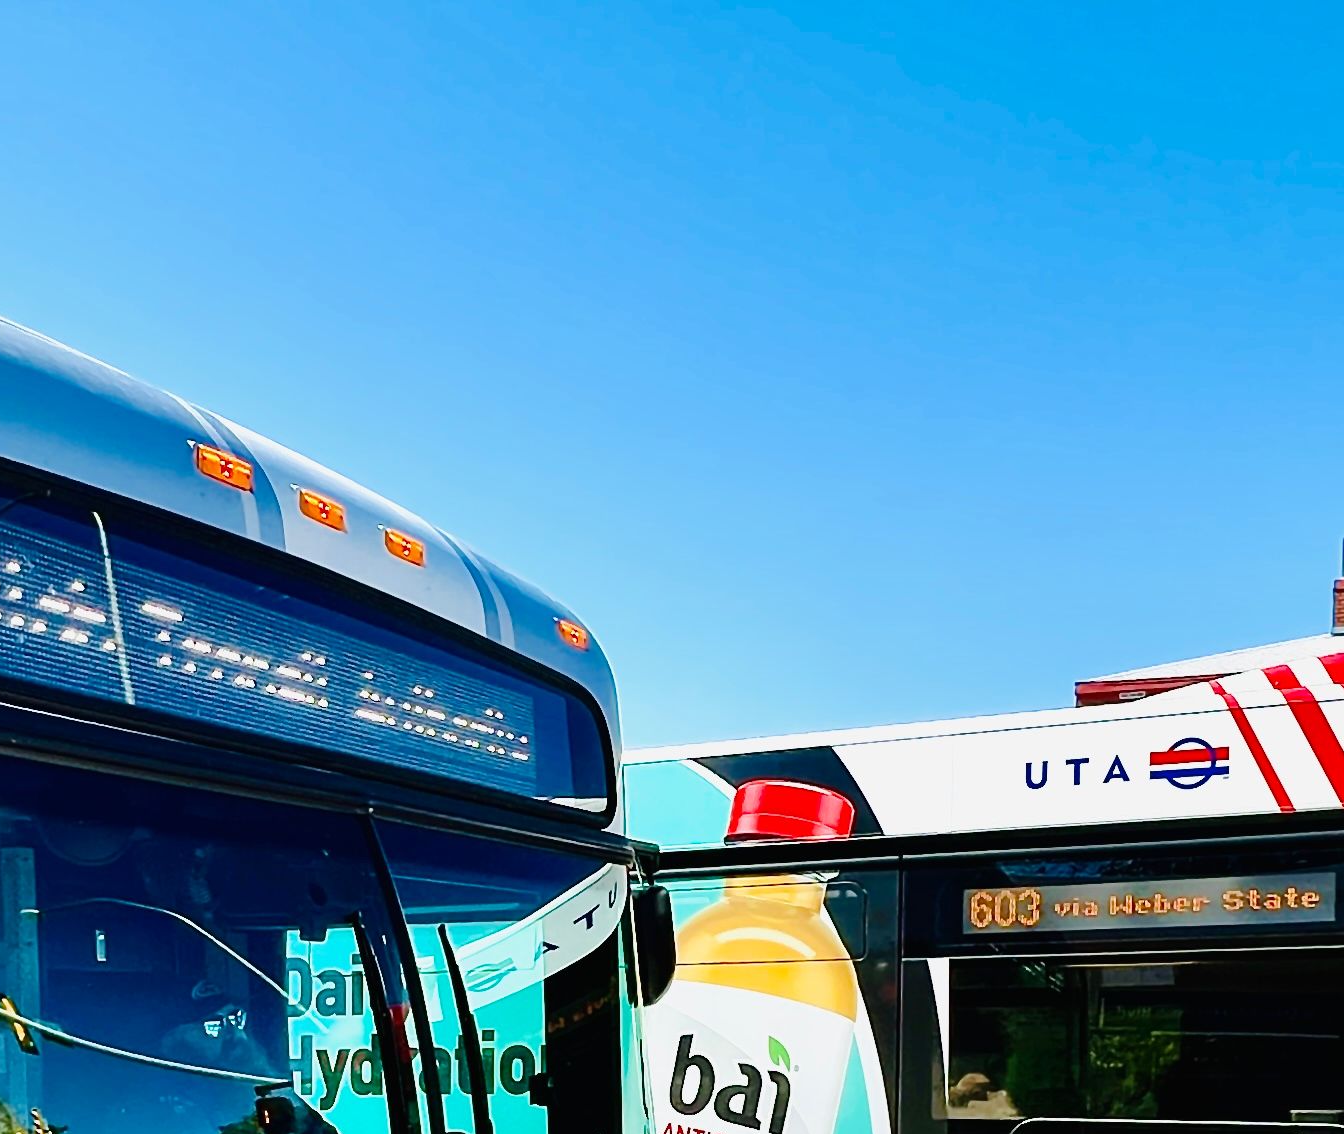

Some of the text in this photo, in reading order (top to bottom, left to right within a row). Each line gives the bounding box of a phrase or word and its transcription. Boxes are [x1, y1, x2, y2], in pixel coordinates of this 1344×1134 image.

[1026, 755, 1130, 789] UTA
[970, 887, 1321, 928] 603 via Weber State
[286, 953, 362, 1017] Dai
[288, 1030, 547, 1111] Hydatio
